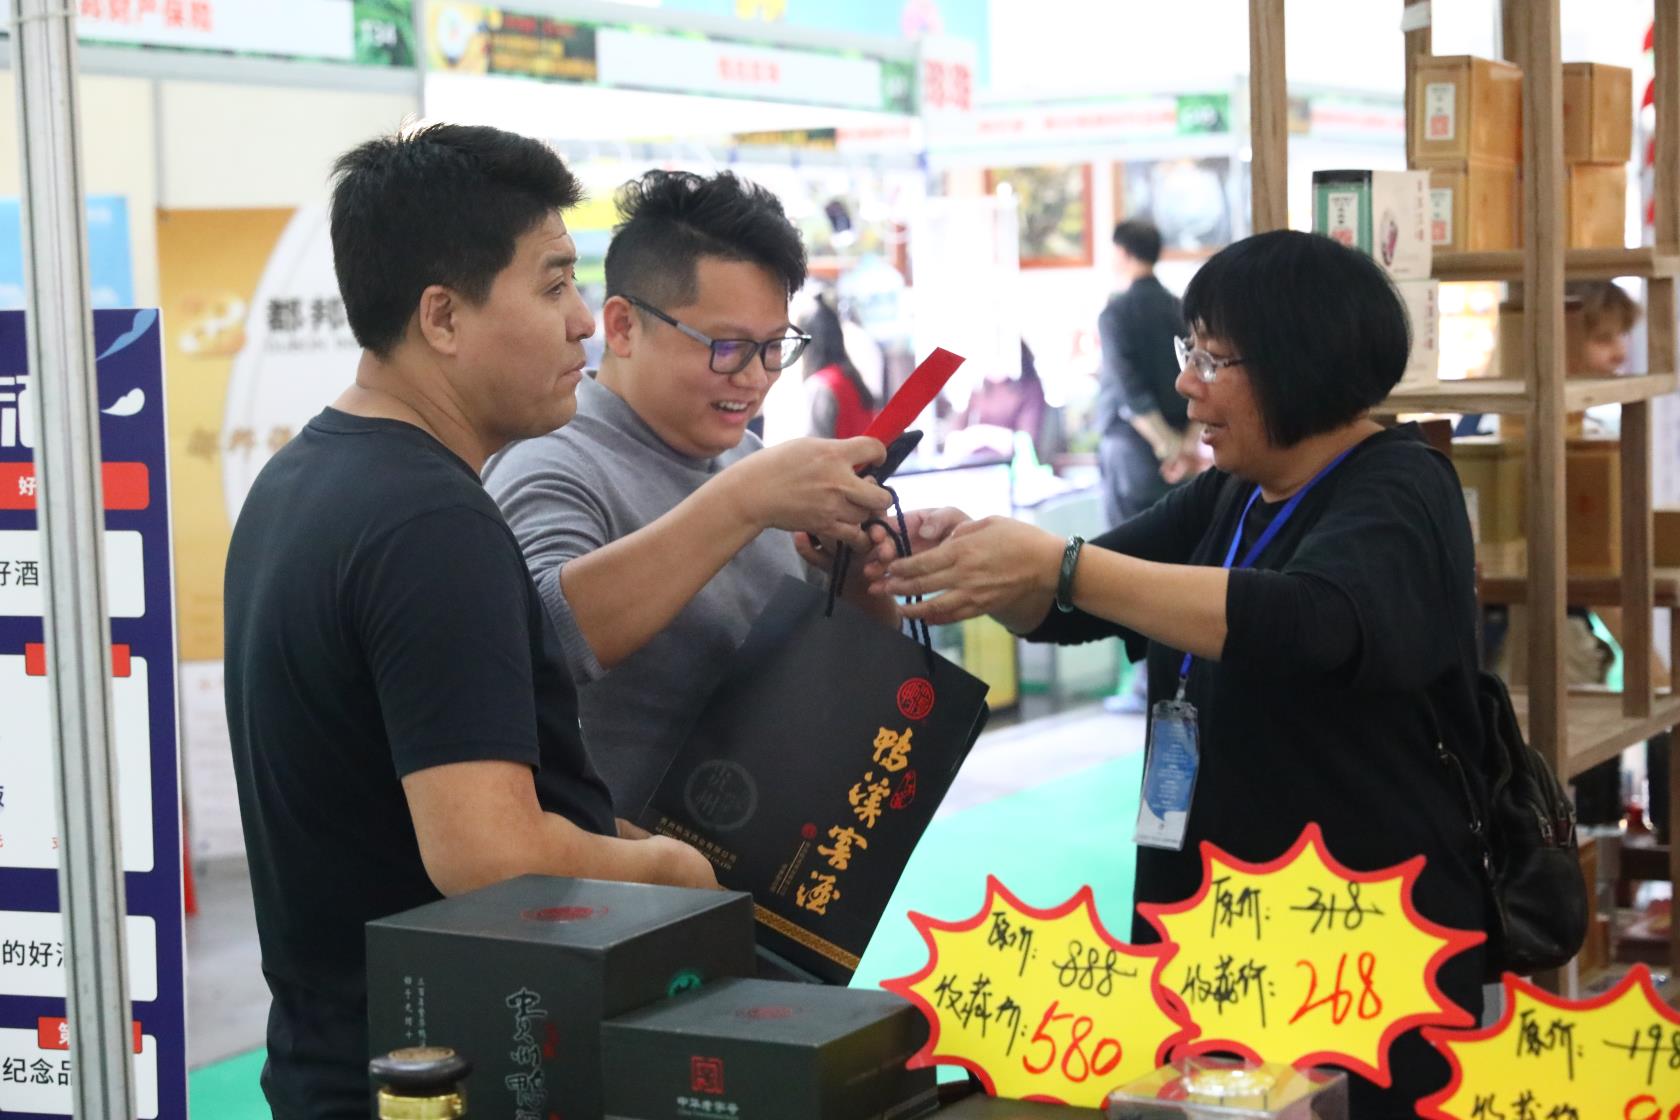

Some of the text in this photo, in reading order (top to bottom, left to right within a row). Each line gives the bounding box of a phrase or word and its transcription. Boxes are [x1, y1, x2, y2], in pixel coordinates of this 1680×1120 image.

[1291, 881, 1384, 932] 318
[1053, 940, 1137, 997] 888
[1289, 951, 1383, 1026] 268
[1022, 1000, 1122, 1082] 580
